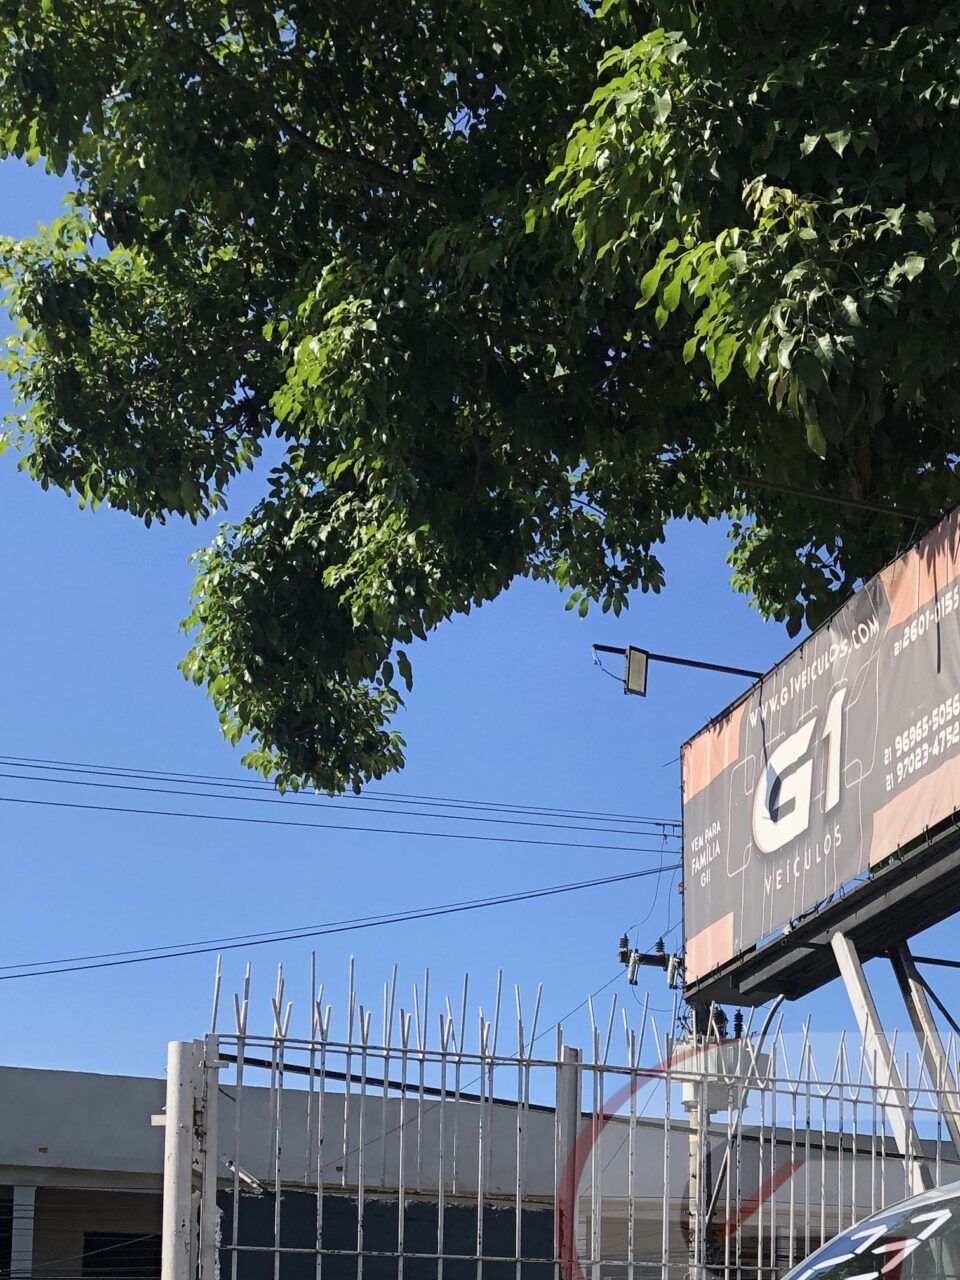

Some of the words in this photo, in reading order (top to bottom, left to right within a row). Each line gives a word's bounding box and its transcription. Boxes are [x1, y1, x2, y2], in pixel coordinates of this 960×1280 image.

[902, 585, 960, 649] 2601-0155
[749, 614, 880, 729] WWW.G1VEICULOS.COM
[884, 746, 892, 766] 21
[894, 693, 960, 757] 96965-5056
[885, 773, 894, 792] 21
[896, 721, 960, 784] 97023-4752
[752, 688, 847, 854] G1
[705, 820, 721, 844] PARA
[765, 824, 842, 895] VEÍCULOS
